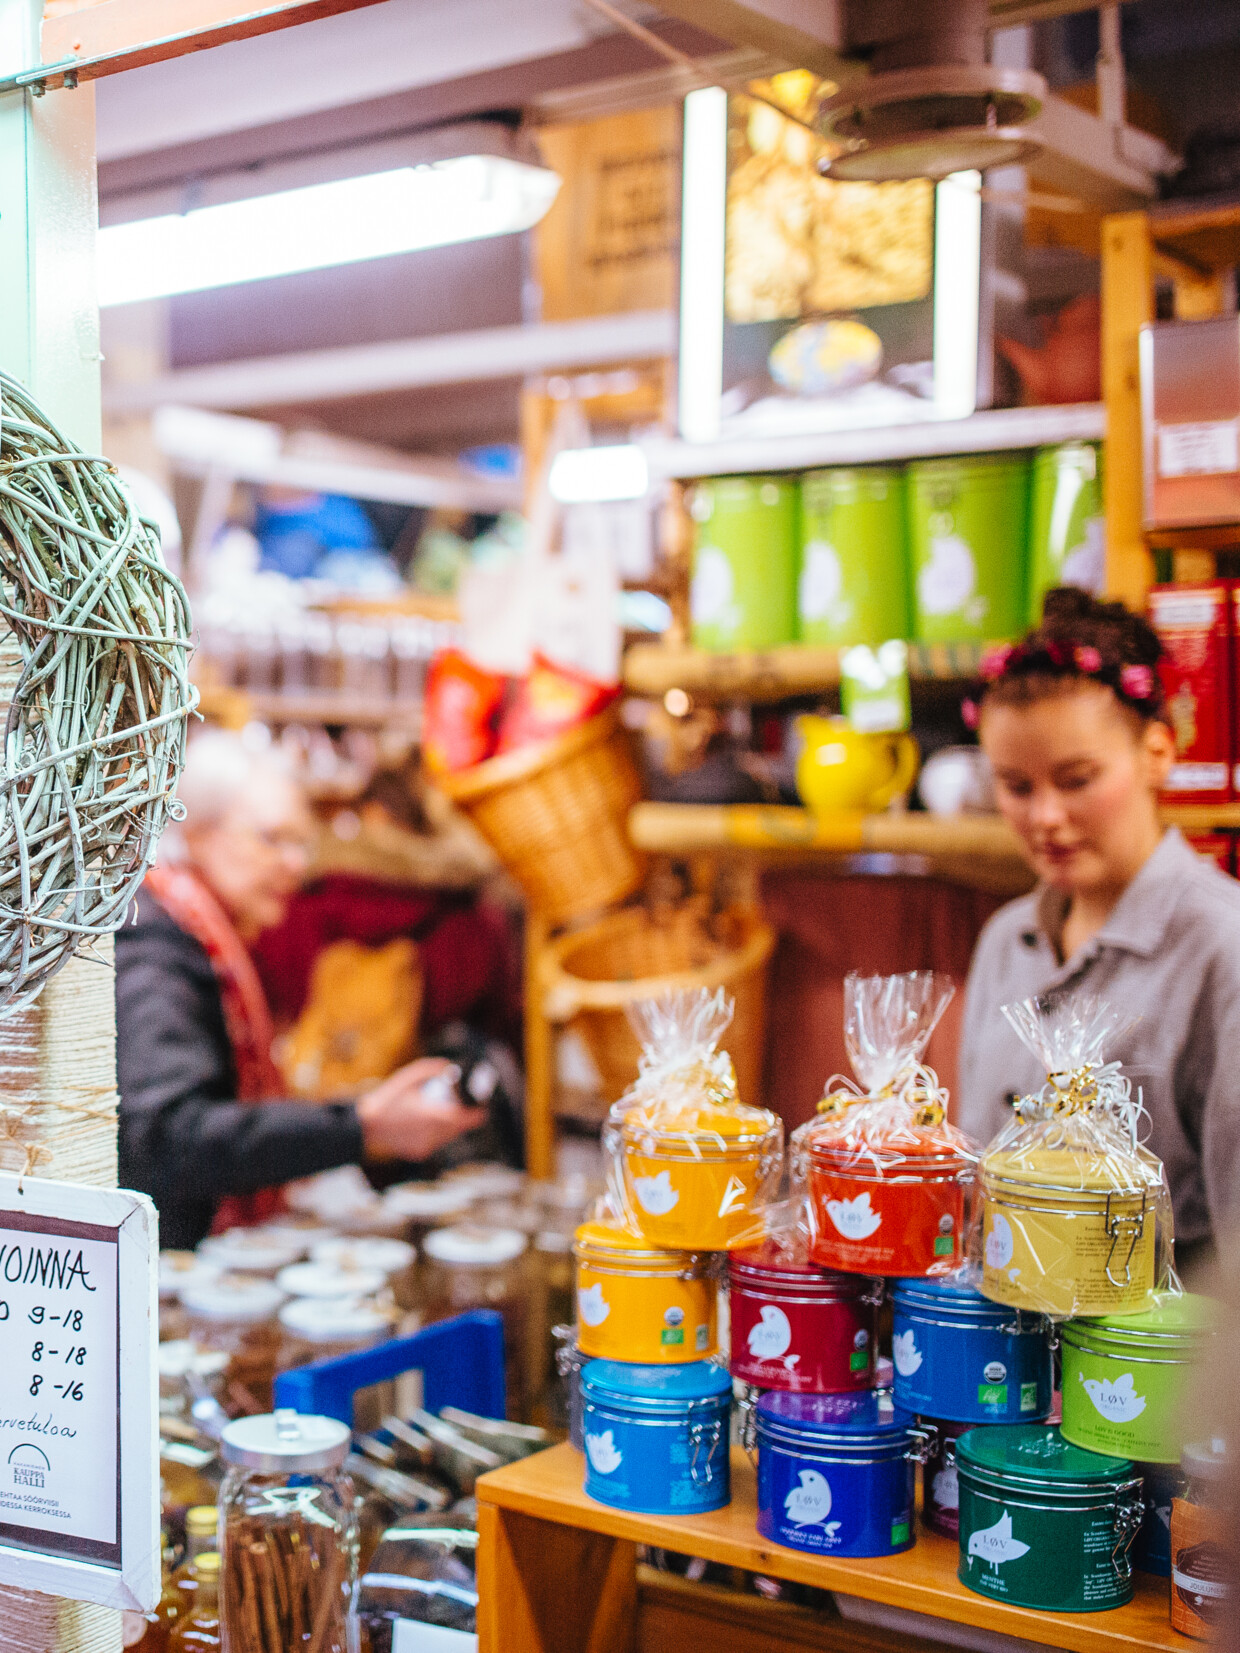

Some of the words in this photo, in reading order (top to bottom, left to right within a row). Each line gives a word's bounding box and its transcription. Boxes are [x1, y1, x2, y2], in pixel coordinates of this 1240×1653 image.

[14, 1467, 45, 1479] KAUPPA
[14, 1475, 45, 1488] HALLI
[0, 1491, 22, 1500] EHTAA
[24, 1505, 71, 1518] KERROKSESSA
